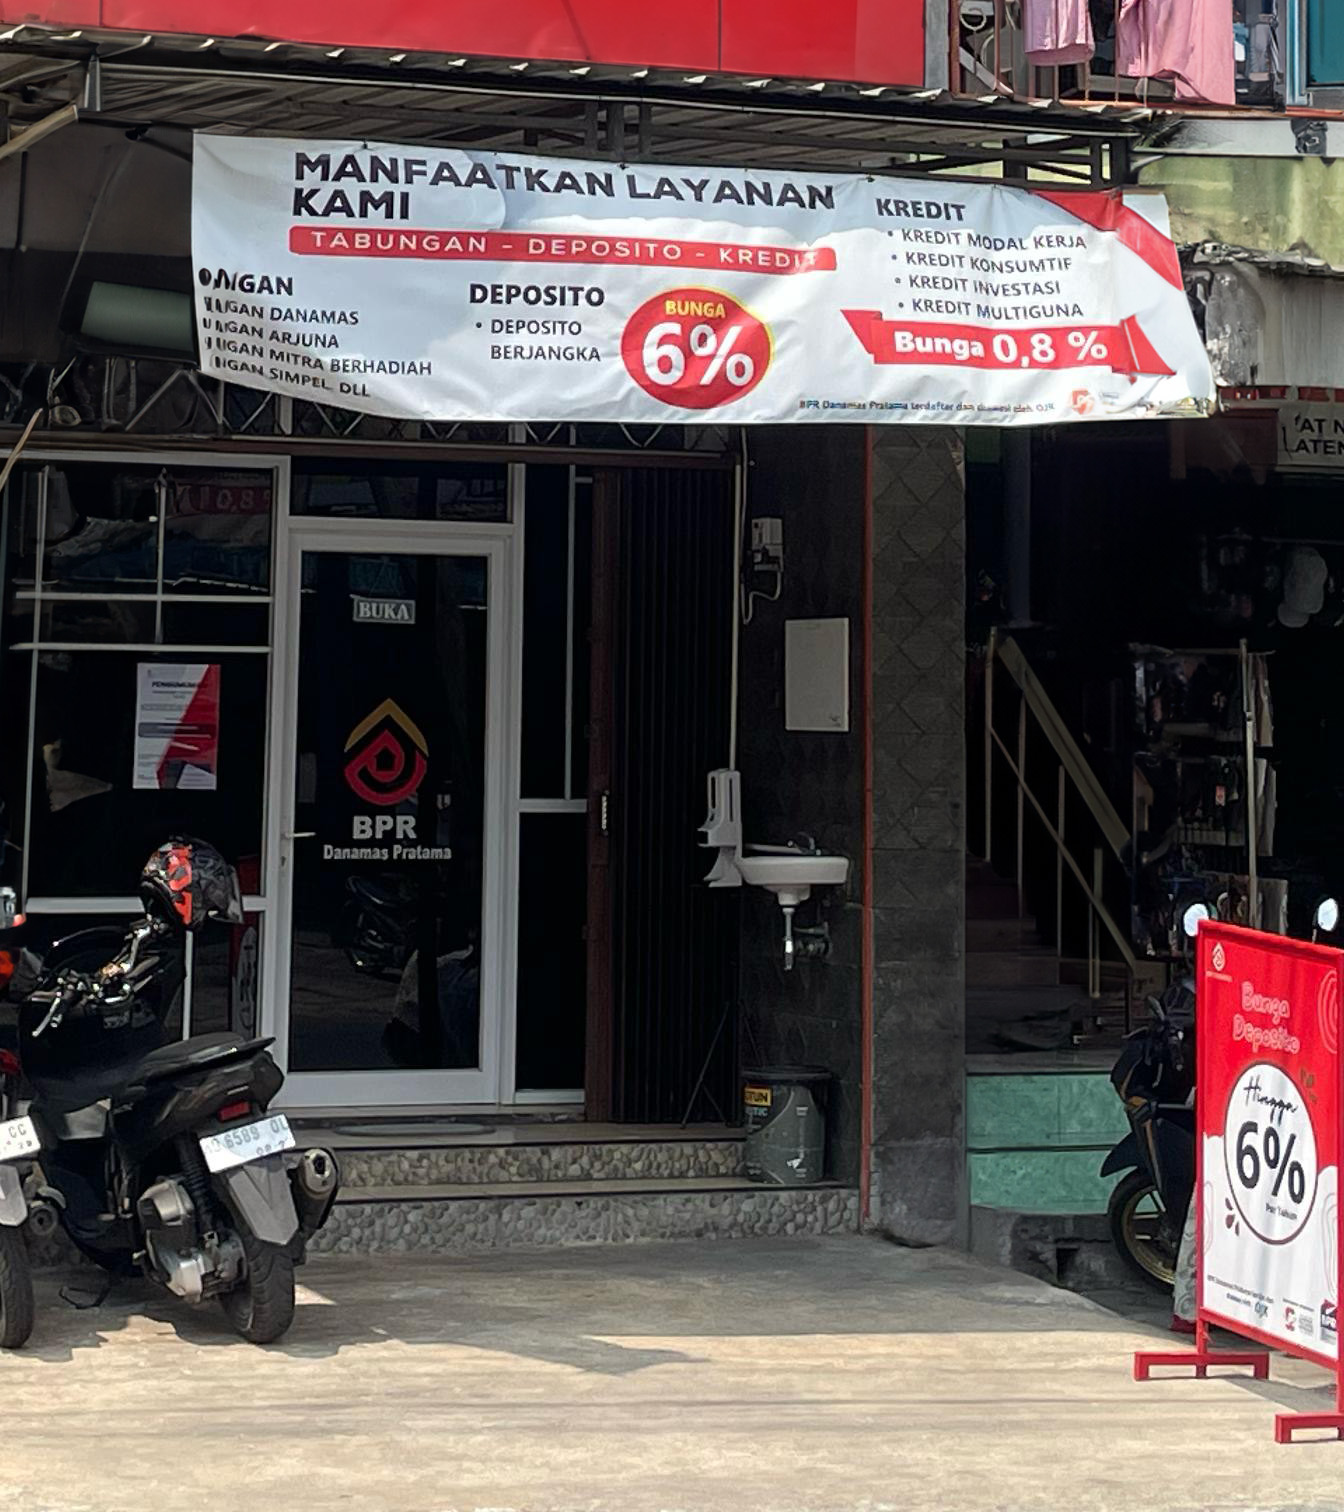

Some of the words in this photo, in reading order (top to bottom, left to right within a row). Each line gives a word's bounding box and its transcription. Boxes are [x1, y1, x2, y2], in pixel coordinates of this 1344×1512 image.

[294, 151, 616, 198] MANFAATKAN
[626, 173, 835, 210] LAYANAN
[292, 187, 410, 221] KAMI
[875, 197, 966, 222] KREDIT
[311, 230, 487, 253] TABUNGAN
[528, 238, 682, 260] DEPOSITO
[719, 247, 819, 268] KREDIT
[902, 228, 962, 245] KREDIT
[967, 232, 1027, 251] MODAL
[1034, 235, 1087, 250] KERJA
[906, 252, 966, 268] KREDIT
[970, 255, 1073, 274] KONSUMTIF
[468, 283, 605, 307] DEPOSITO
[909, 275, 969, 292] KREDIT
[974, 280, 1061, 297] INVESTASI
[269, 307, 359, 326] DANAMAS
[665, 300, 726, 319] BUNGA
[912, 298, 972, 316] KREDIT
[977, 303, 1084, 321] MULTIGUNA
[268, 330, 340, 349] ARJUNA
[490, 319, 582, 336] DEPOSITO
[490, 344, 602, 363] BERJANGKA
[641, 321, 755, 387] 6%
[893, 330, 985, 361] Bunga
[269, 349, 324, 371] MITRA
[330, 358, 433, 376] BERHADIAH
[269, 367, 332, 389] SIMPEL
[339, 381, 371, 398] DLL
[359, 601, 410, 620] BUKA
[352, 815, 417, 840] BPR
[323, 844, 389, 861] Danamas
[392, 844, 453, 860] Pratama
[1241, 981, 1291, 1025] Bunga
[1232, 1013, 1301, 1055] Deposito
[1236, 1120, 1306, 1205] 6%
